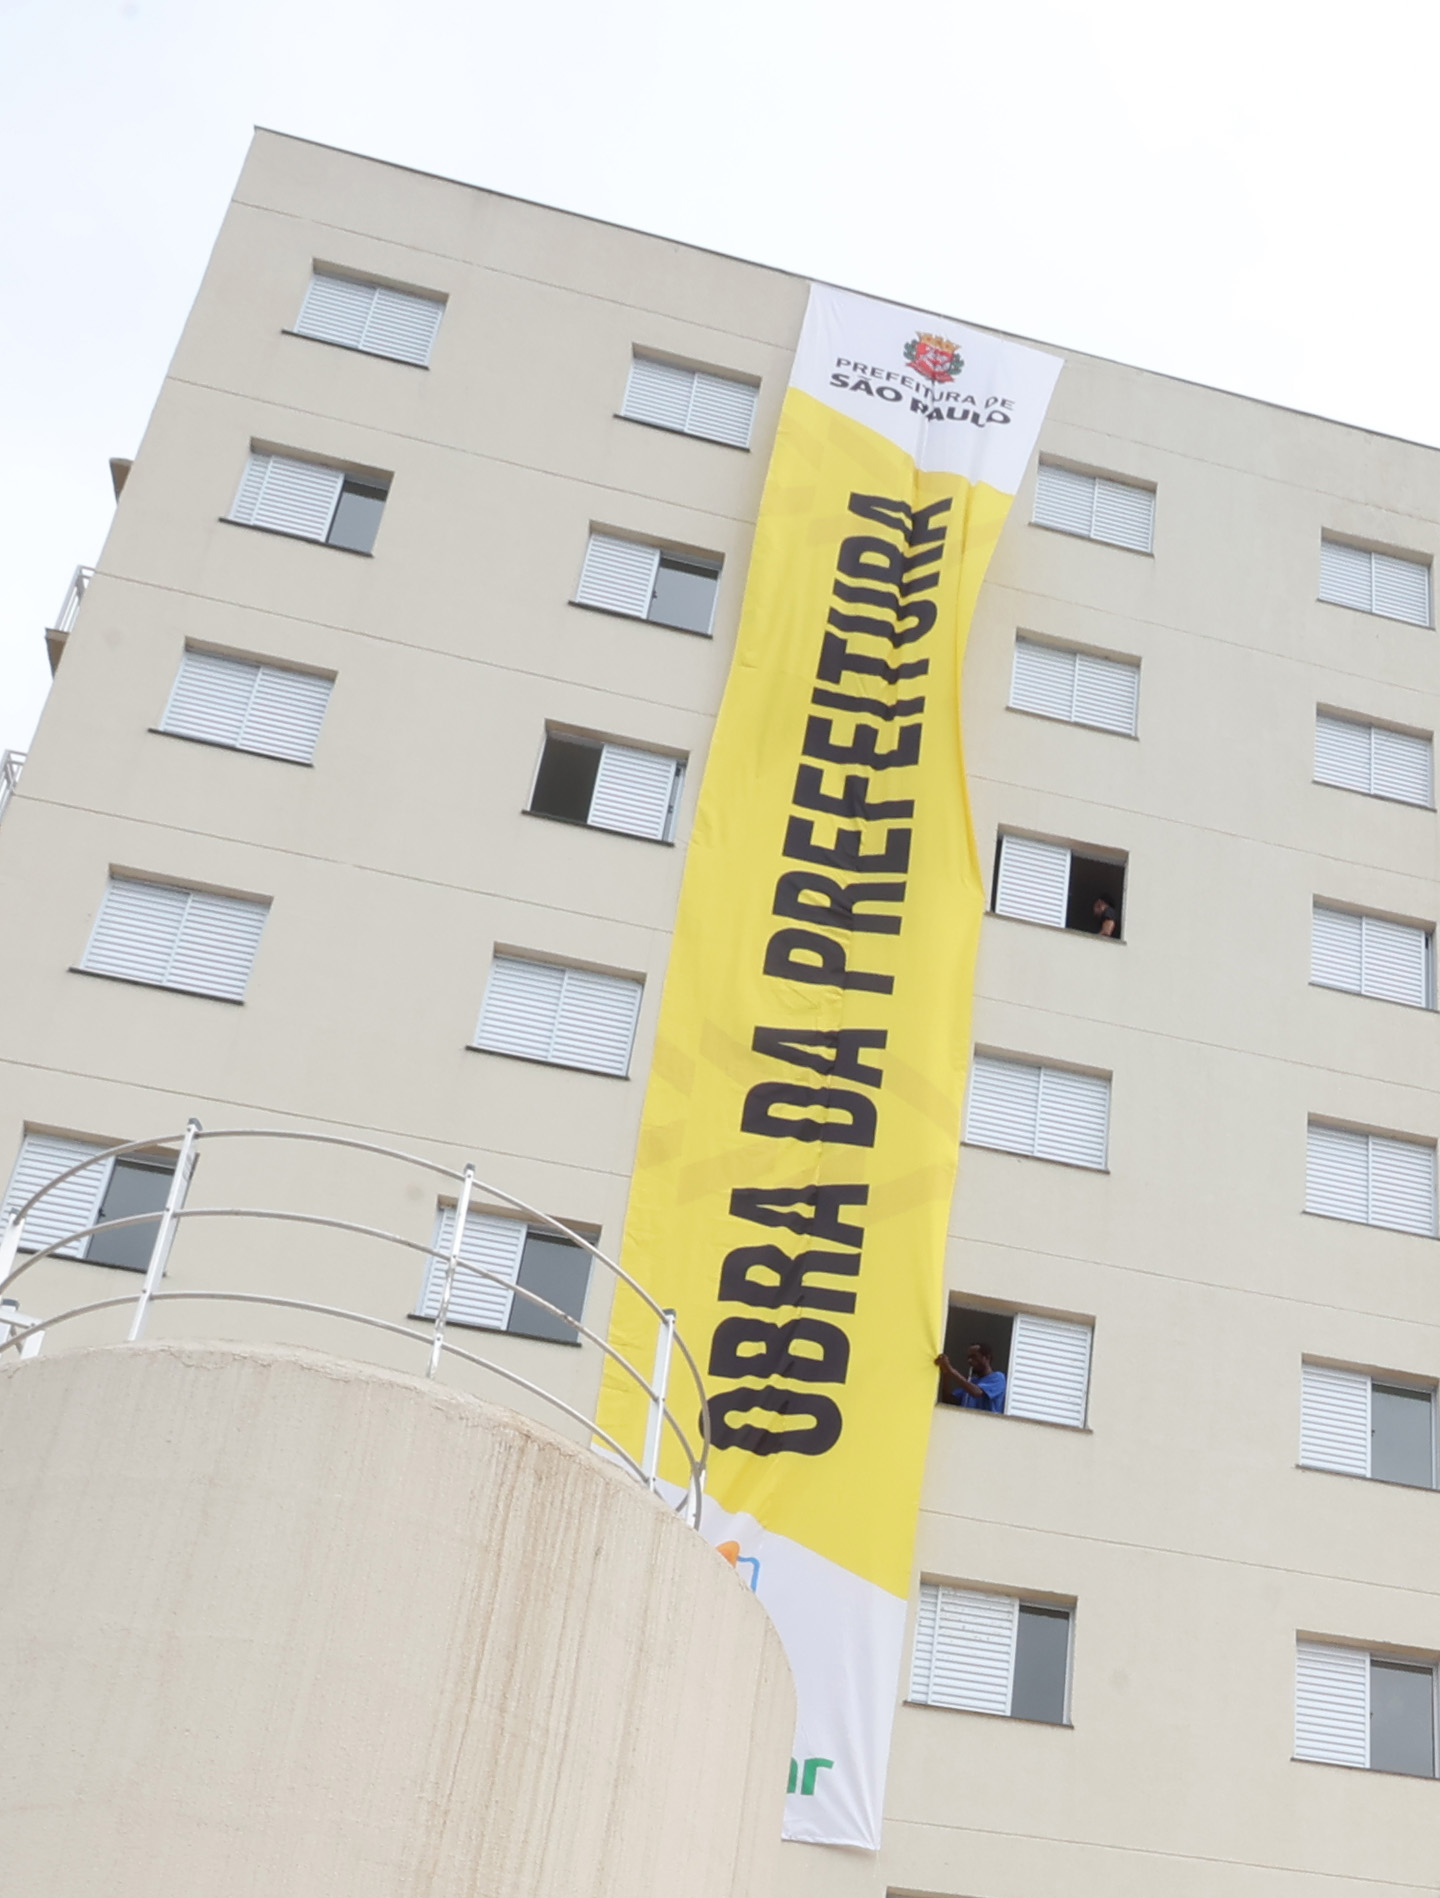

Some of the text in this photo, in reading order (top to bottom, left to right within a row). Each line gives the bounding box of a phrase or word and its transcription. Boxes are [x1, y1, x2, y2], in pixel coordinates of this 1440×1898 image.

[829, 373, 1011, 428] SÃO PAULO
[836, 357, 1016, 411] PREFEITURA DE
[698, 491, 954, 1457] OBRA DA PREFEITURA
